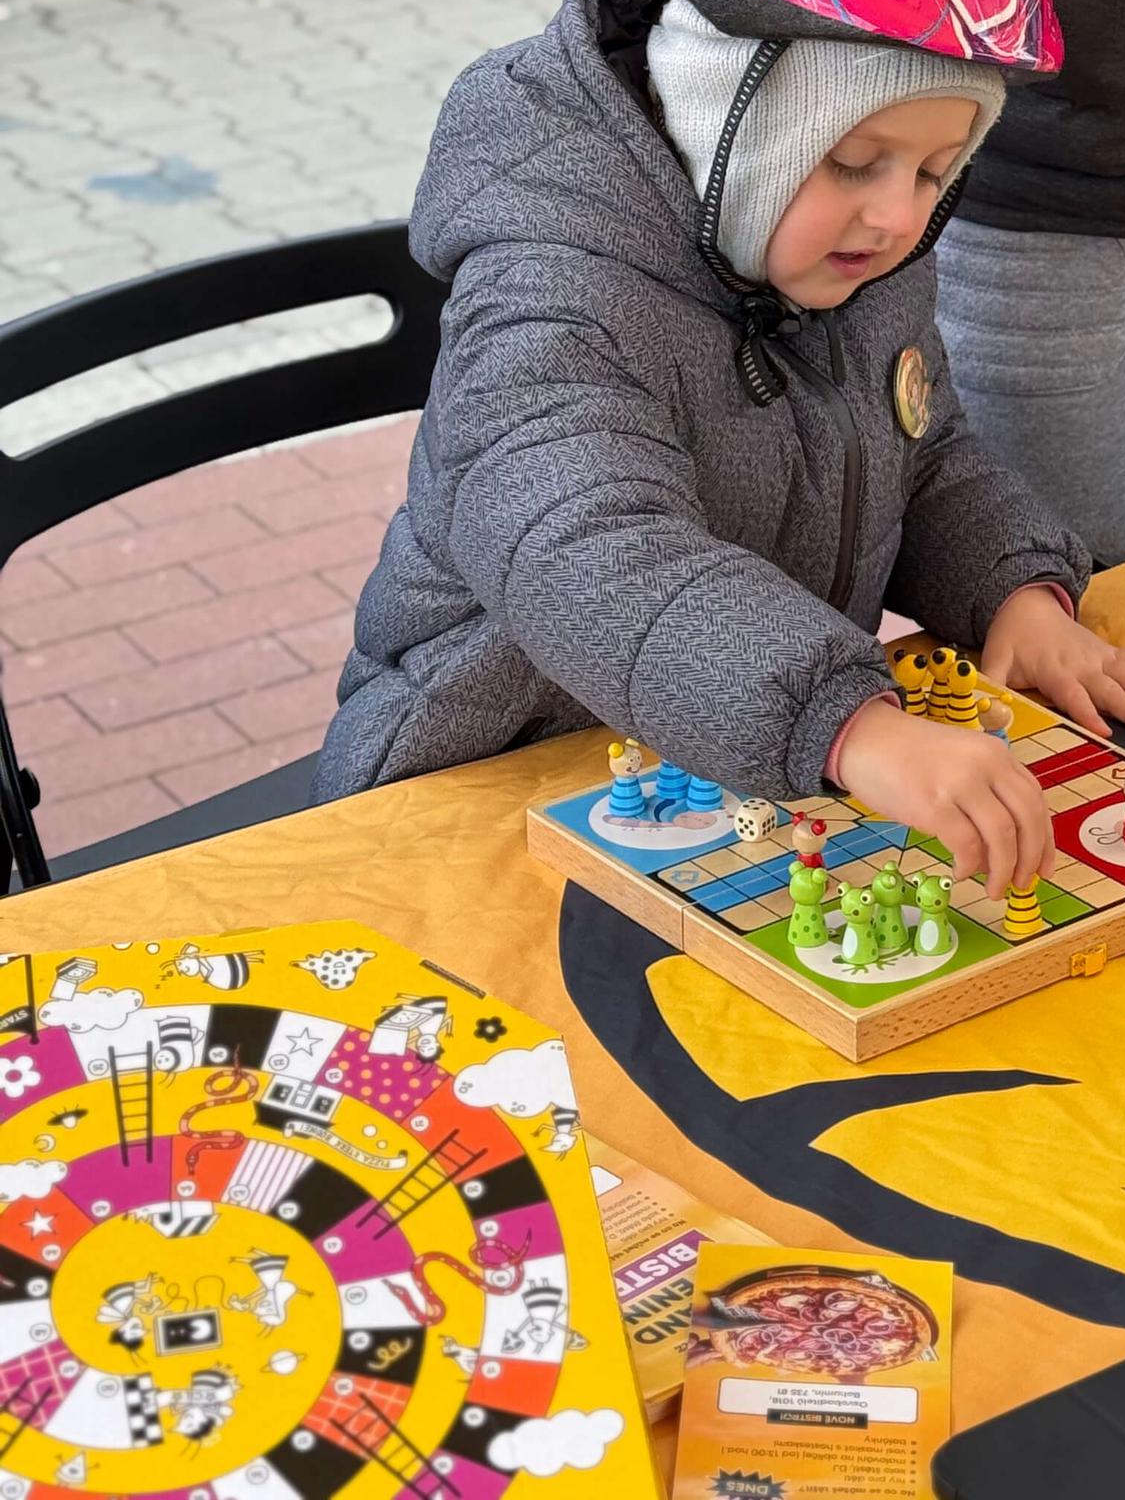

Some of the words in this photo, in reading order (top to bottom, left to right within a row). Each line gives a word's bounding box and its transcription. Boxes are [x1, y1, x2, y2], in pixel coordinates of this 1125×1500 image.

[0, 1009, 29, 1029] STAR
[615, 1243, 698, 1296] BISTR
[622, 1278, 693, 1325] ENIN
[634, 1303, 692, 1344] AND
[824, 1416, 855, 1424] NOVÉ
[832, 1464, 847, 1472] DJ
[726, 1481, 768, 1495] DNES
